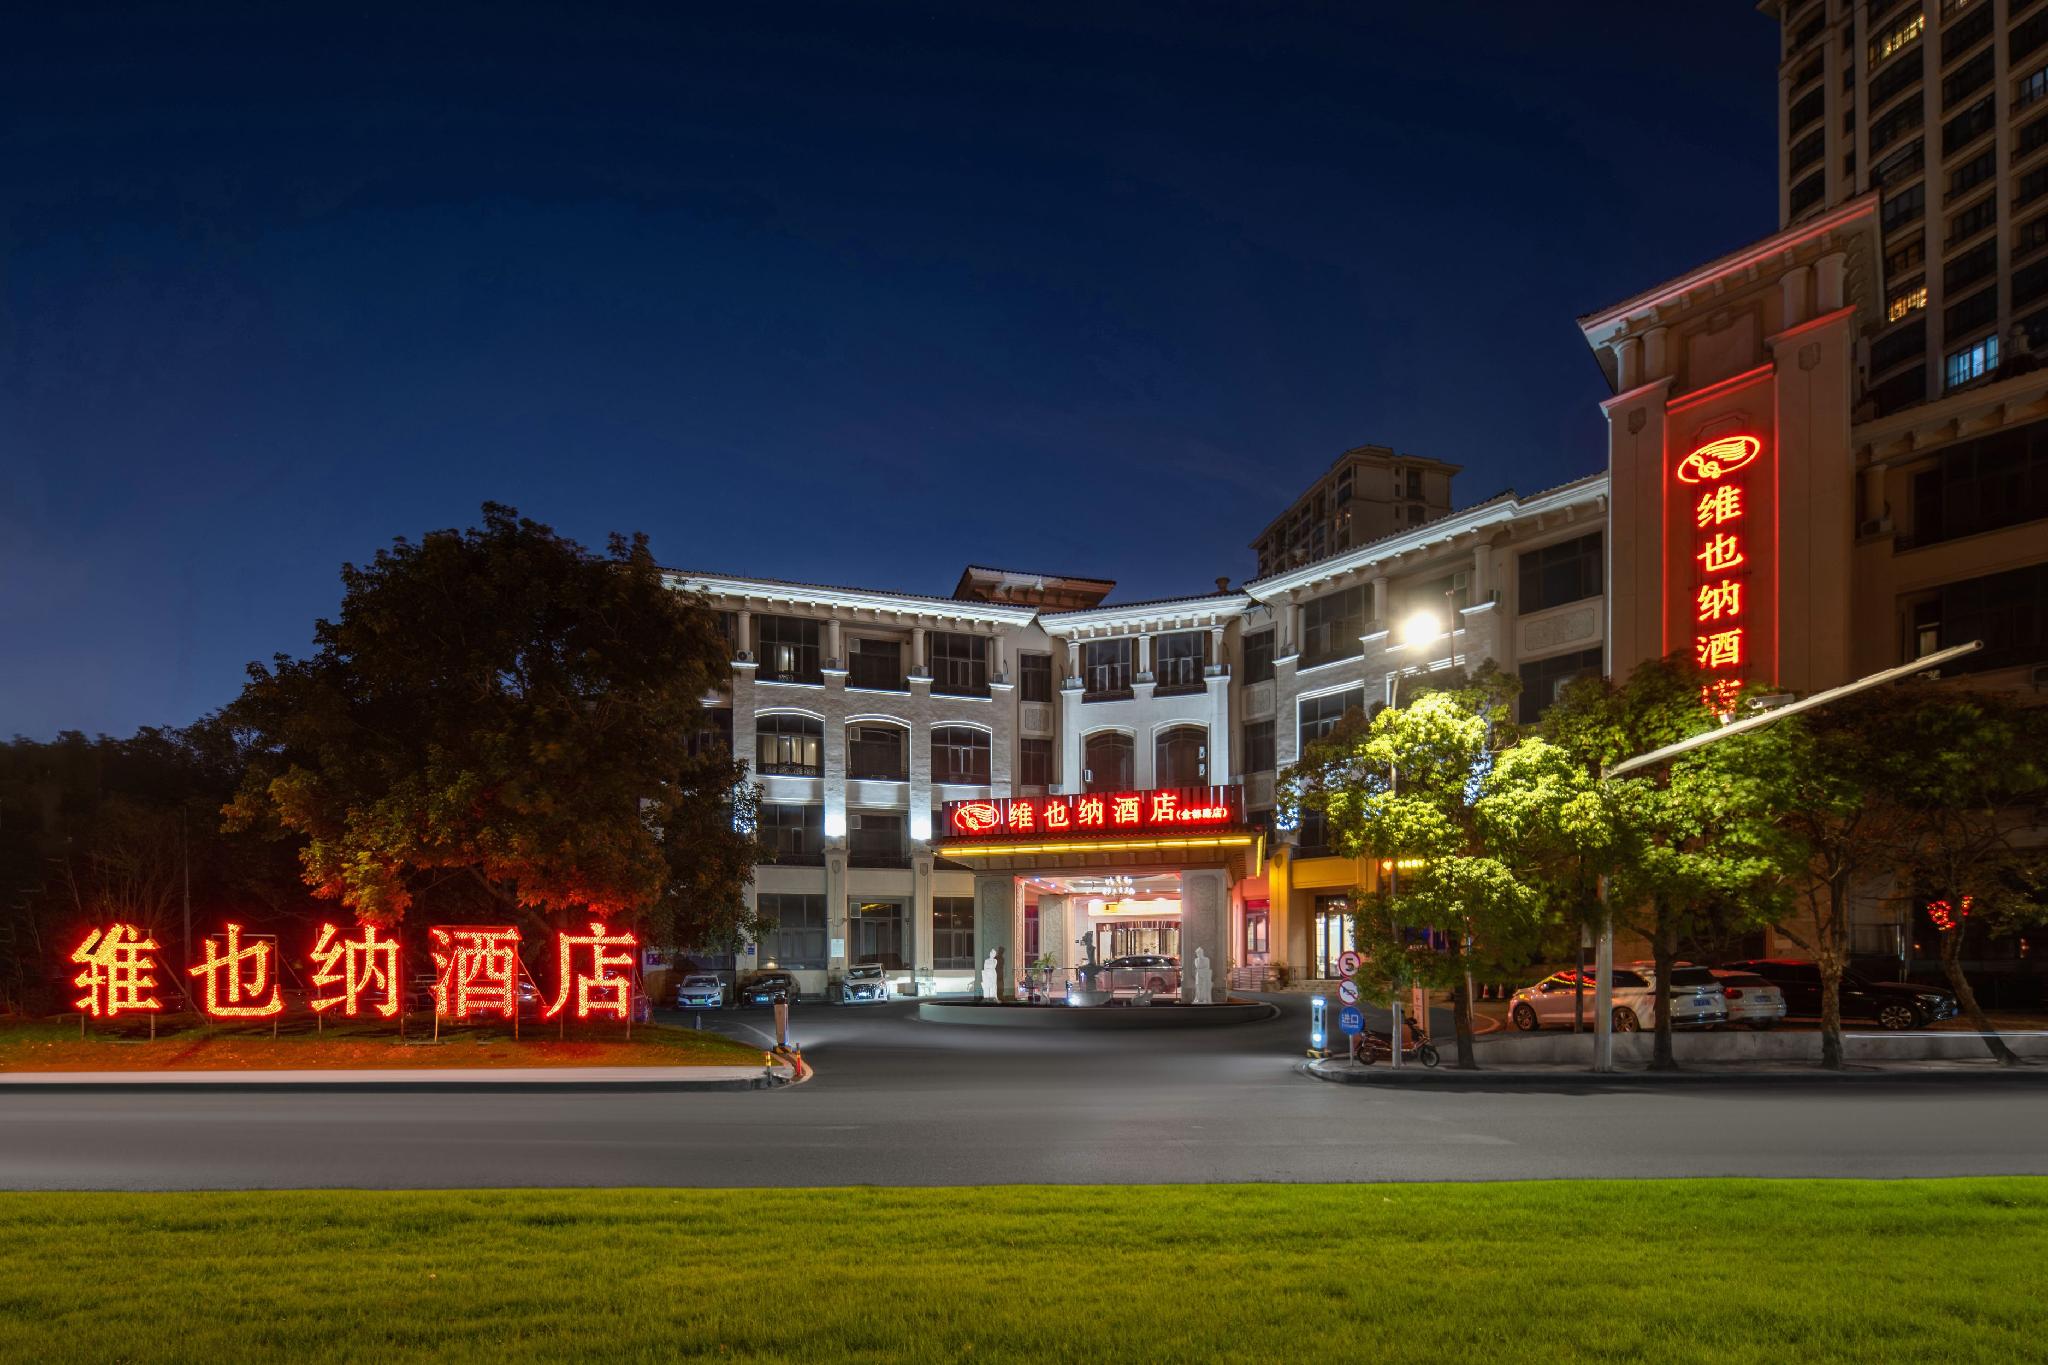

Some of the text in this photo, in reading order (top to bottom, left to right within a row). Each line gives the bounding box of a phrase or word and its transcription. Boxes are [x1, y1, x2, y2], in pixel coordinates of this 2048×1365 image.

[1008, 792, 1177, 829] 维也纳酒店
[71, 922, 637, 1018] 维也纳酒店
[1345, 957, 1355, 972] 5
